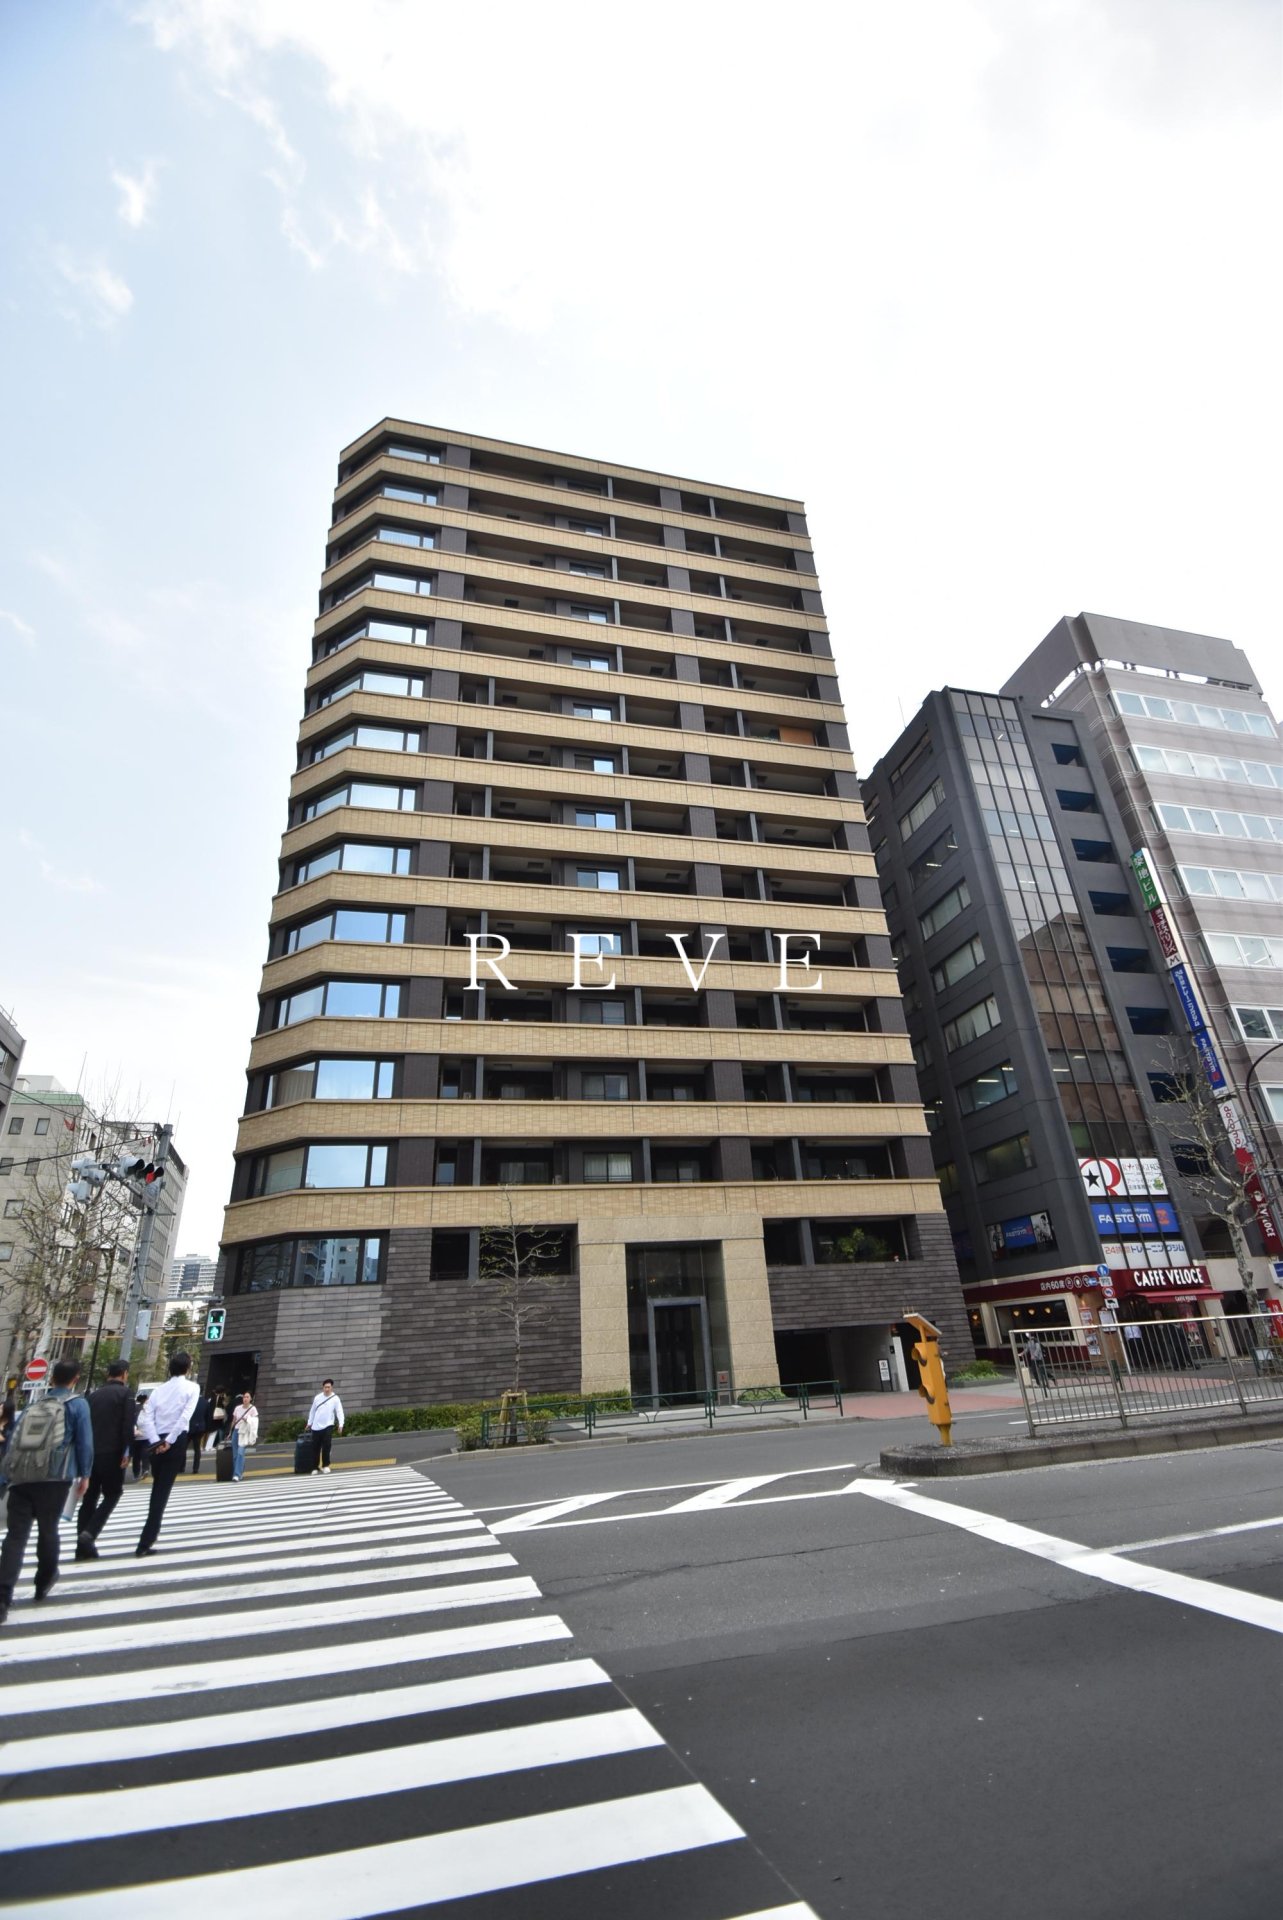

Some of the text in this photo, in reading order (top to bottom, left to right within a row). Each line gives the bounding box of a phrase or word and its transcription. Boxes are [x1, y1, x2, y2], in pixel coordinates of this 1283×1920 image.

[1223, 1105, 1242, 1146] docomo
[1098, 1213, 1153, 1224] FASTGYM
[1165, 1268, 1204, 1285] VELOCE
